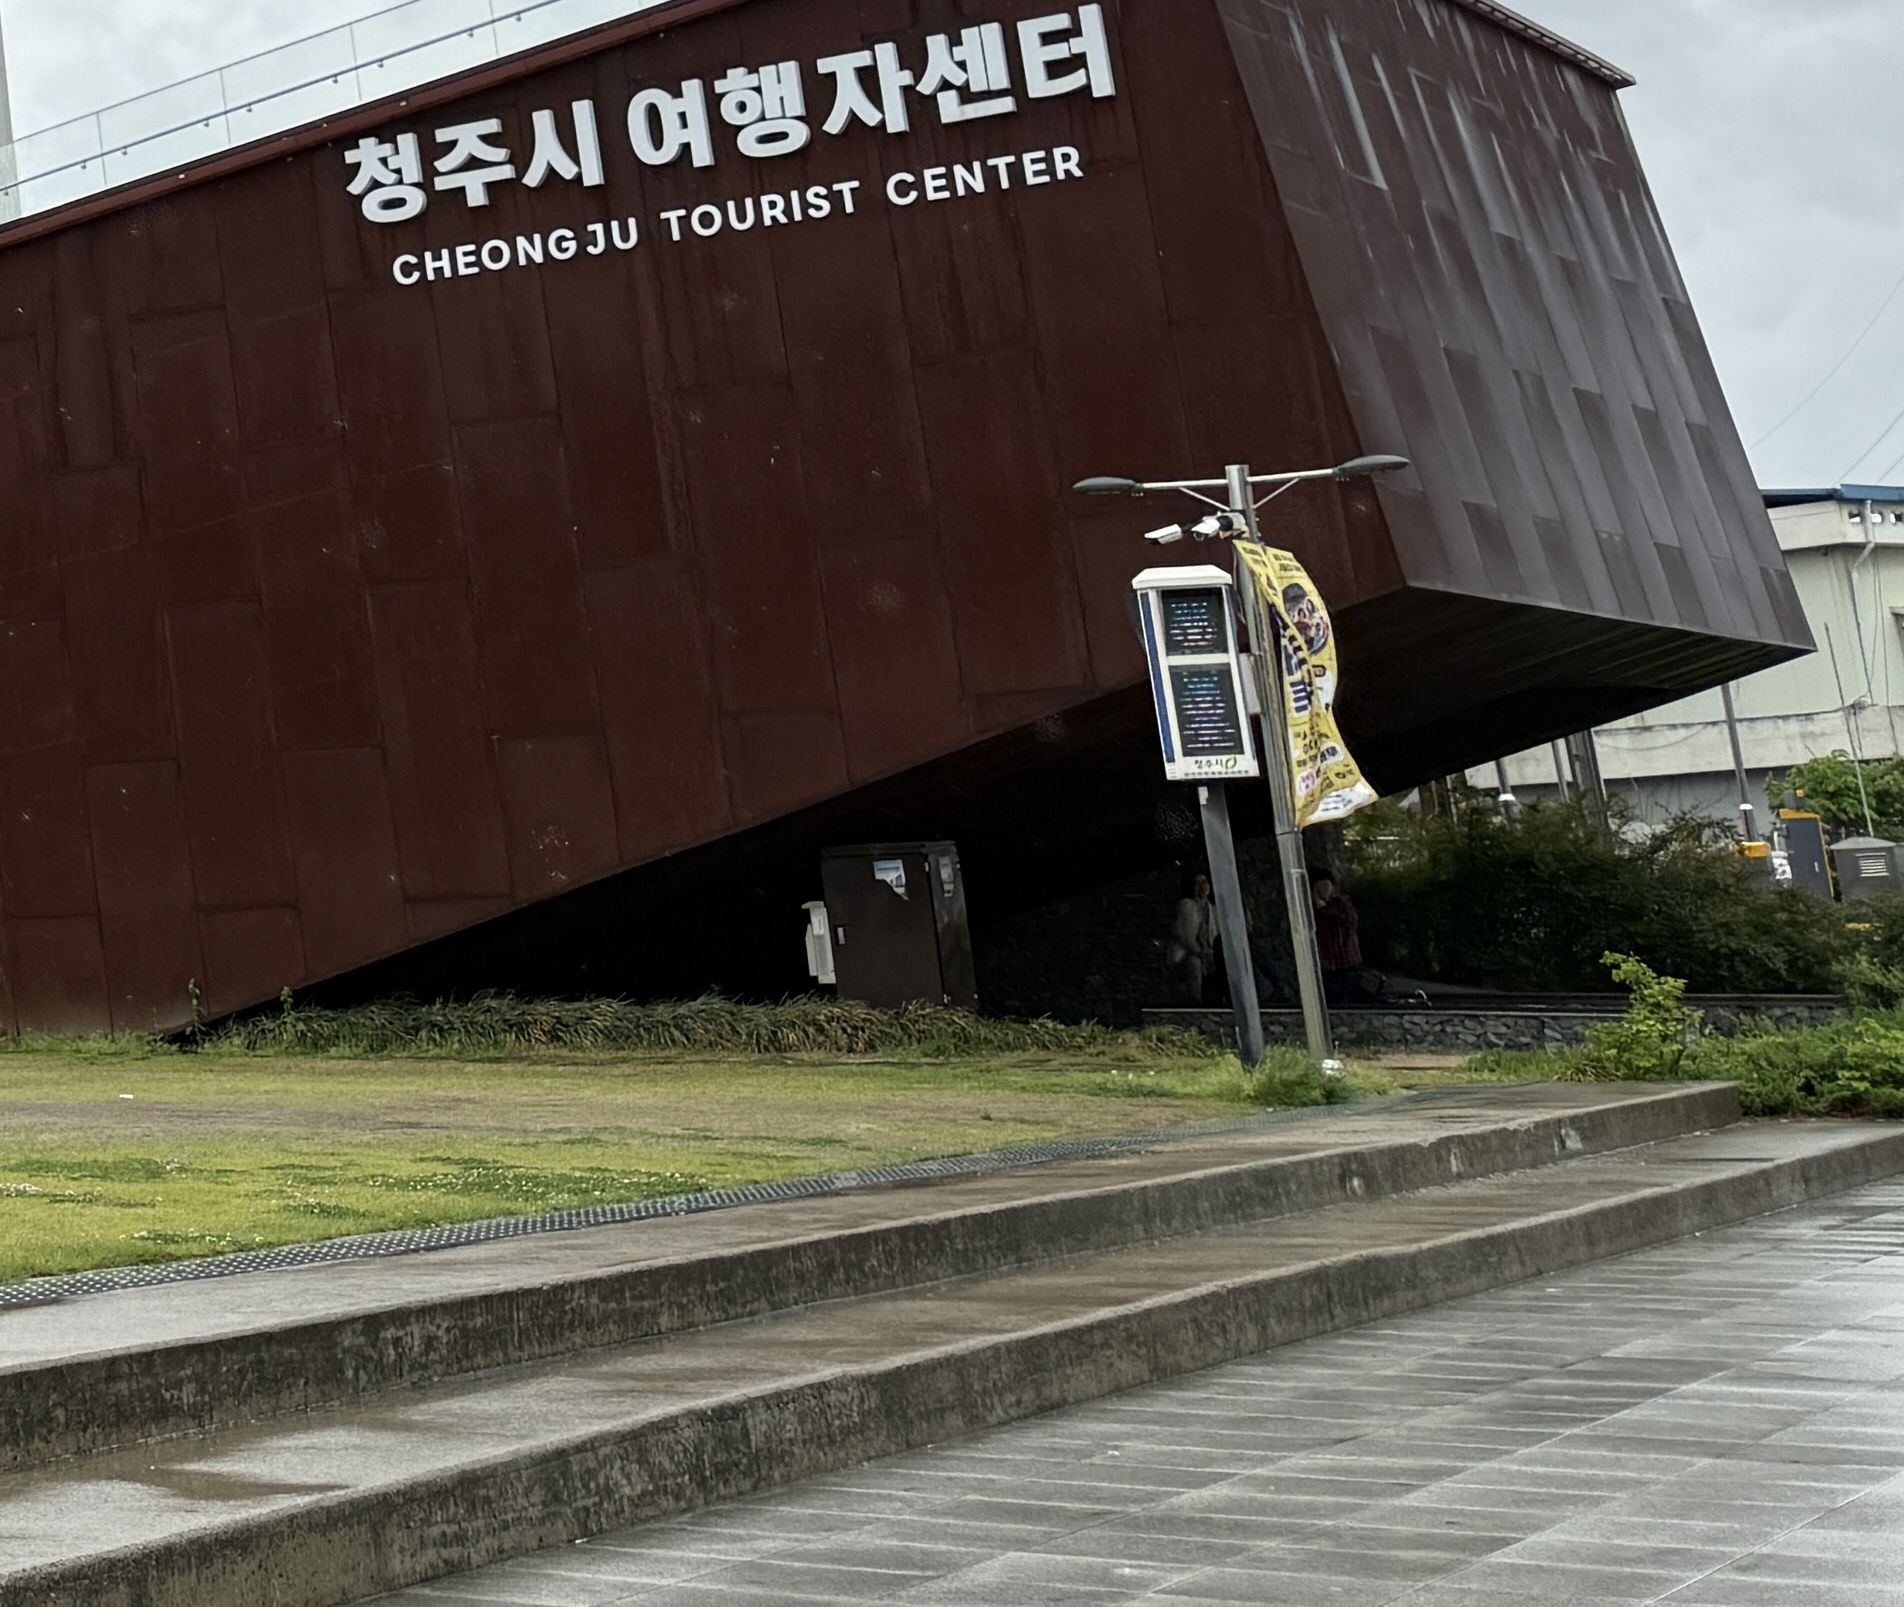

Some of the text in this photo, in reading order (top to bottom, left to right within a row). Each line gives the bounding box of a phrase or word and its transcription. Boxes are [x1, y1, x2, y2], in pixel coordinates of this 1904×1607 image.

[344, 2, 1116, 224] 청주시 여행자센터
[392, 146, 1085, 287] CHEONGJU TOURIST CENTER
